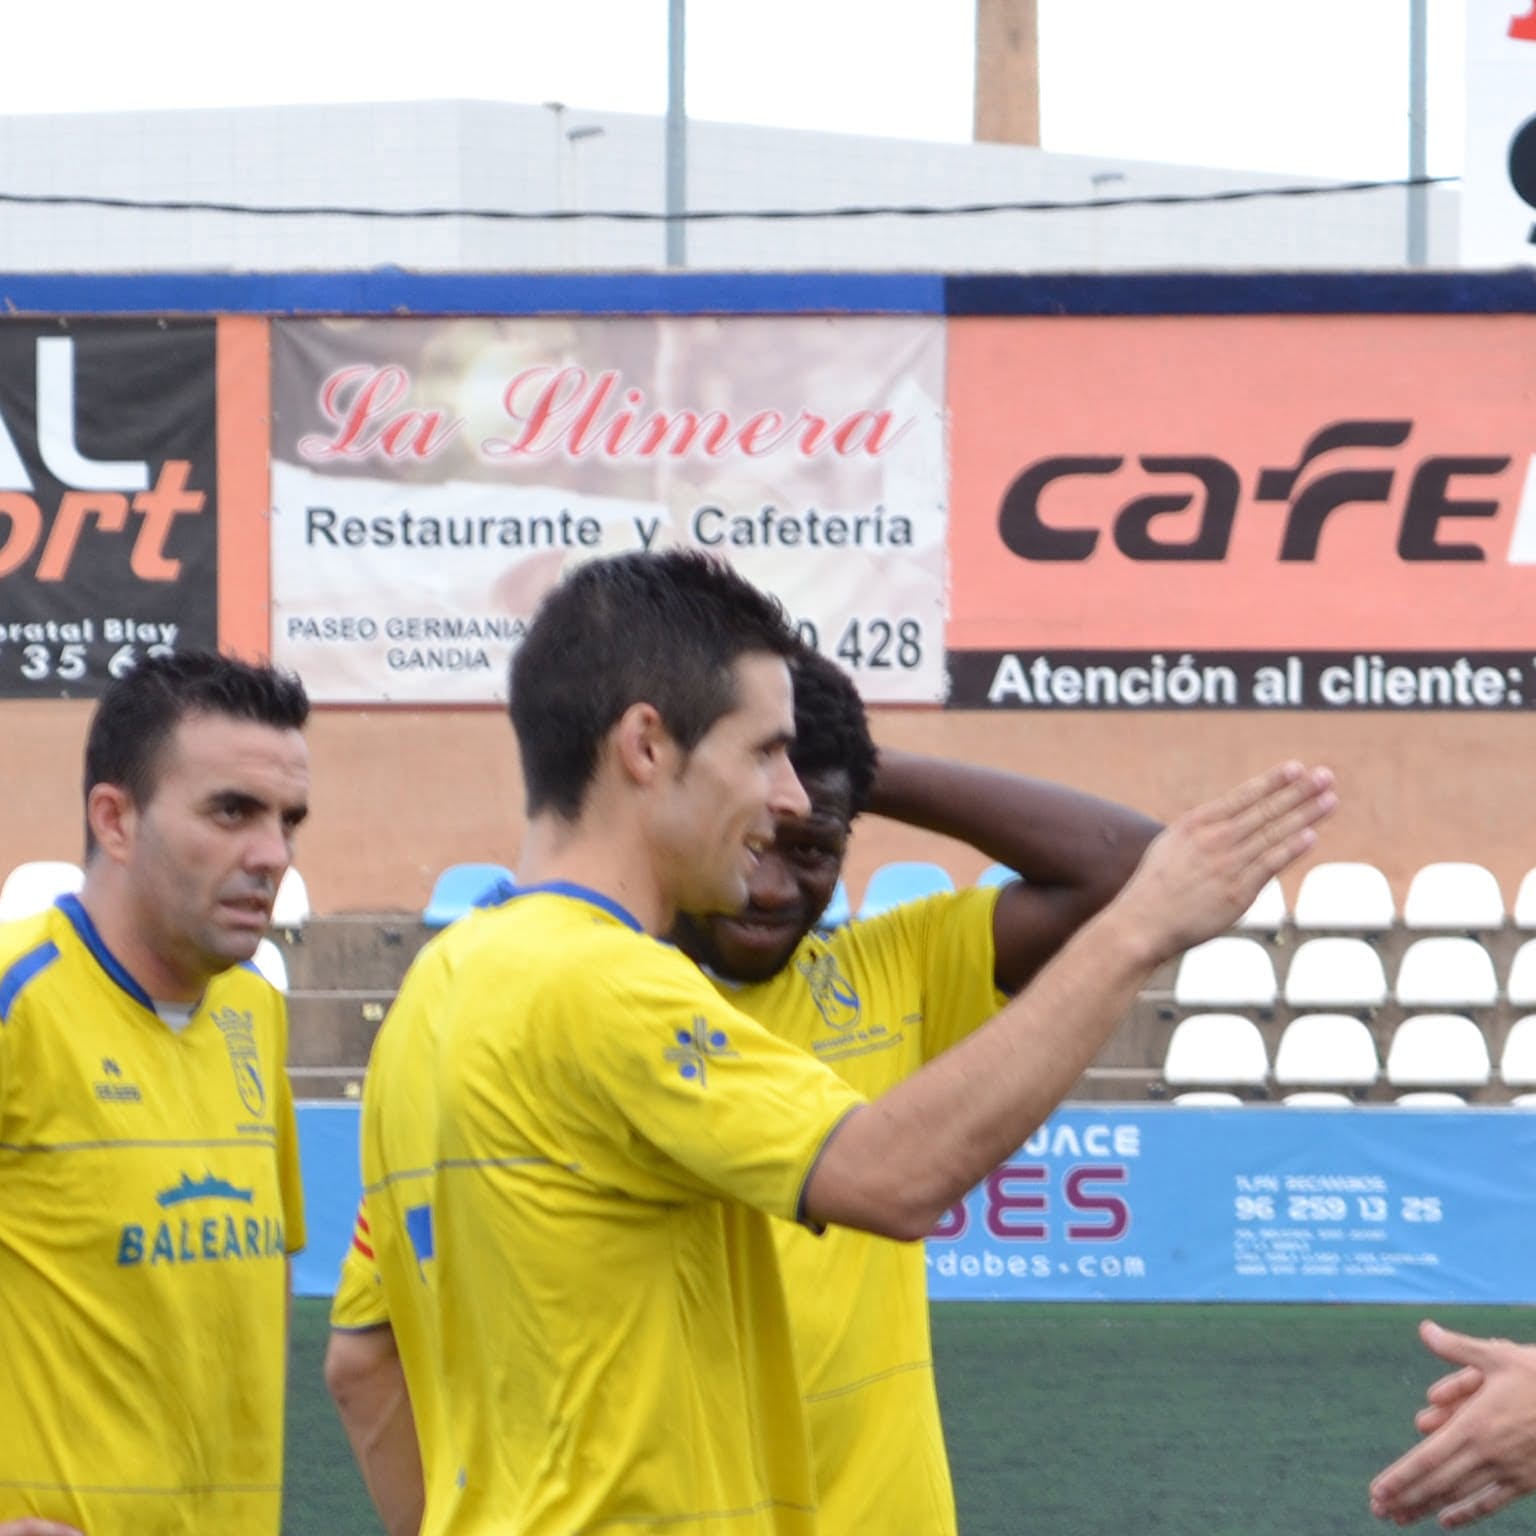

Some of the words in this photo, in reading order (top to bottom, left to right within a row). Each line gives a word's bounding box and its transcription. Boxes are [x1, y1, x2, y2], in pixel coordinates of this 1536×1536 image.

[297, 365, 464, 459] La
[480, 365, 916, 459] Llimera
[305, 507, 602, 548] Restaurante
[633, 515, 661, 552] y
[103, 618, 179, 646] Blay
[287, 617, 377, 641] PASEO
[837, 618, 922, 668] 428
[20, 645, 87, 681] 35
[388, 648, 491, 671] GANDIA
[988, 654, 1237, 703] Atención
[1254, 658, 1301, 703] al
[1319, 655, 1523, 703] cliente:
